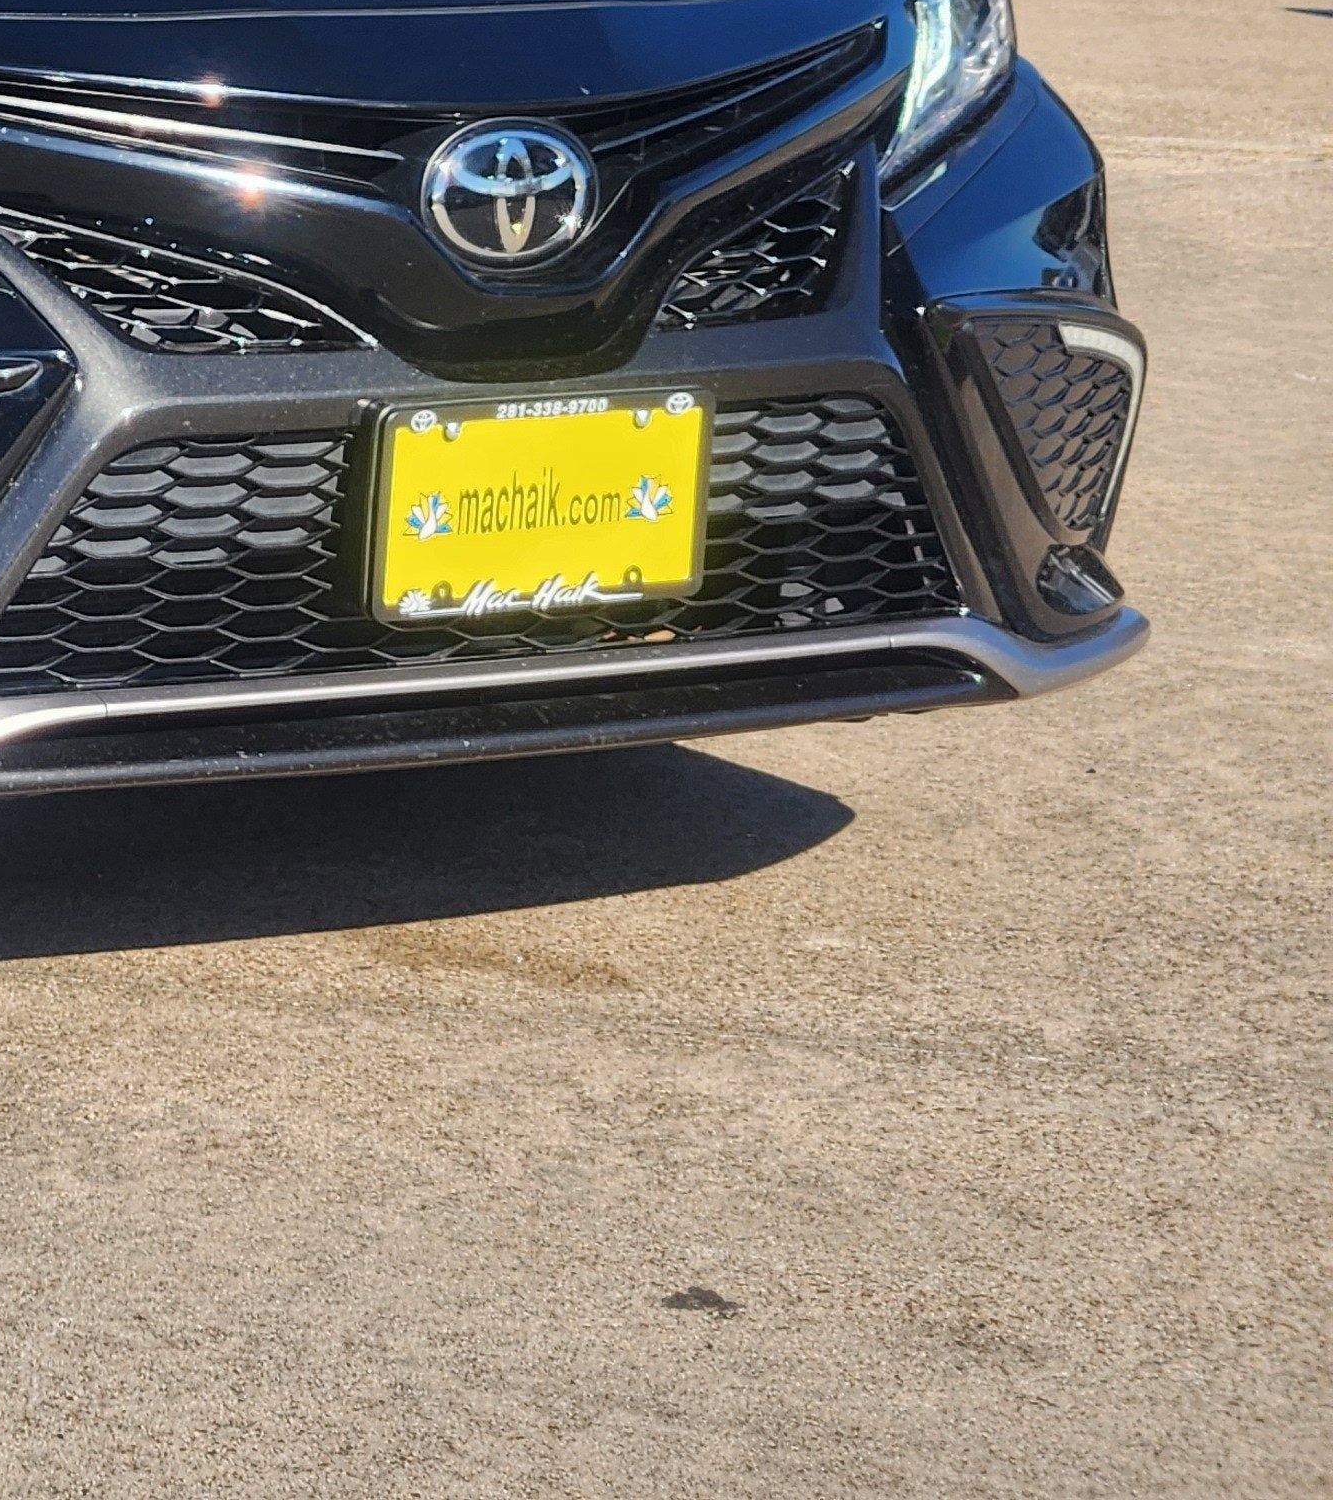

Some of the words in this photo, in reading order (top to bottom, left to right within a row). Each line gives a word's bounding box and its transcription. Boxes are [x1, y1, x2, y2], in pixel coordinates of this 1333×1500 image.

[495, 397, 610, 420] 281-338-9700
[457, 466, 621, 536] machaik.com
[461, 578, 523, 616] Mac
[532, 570, 603, 612] Haik
